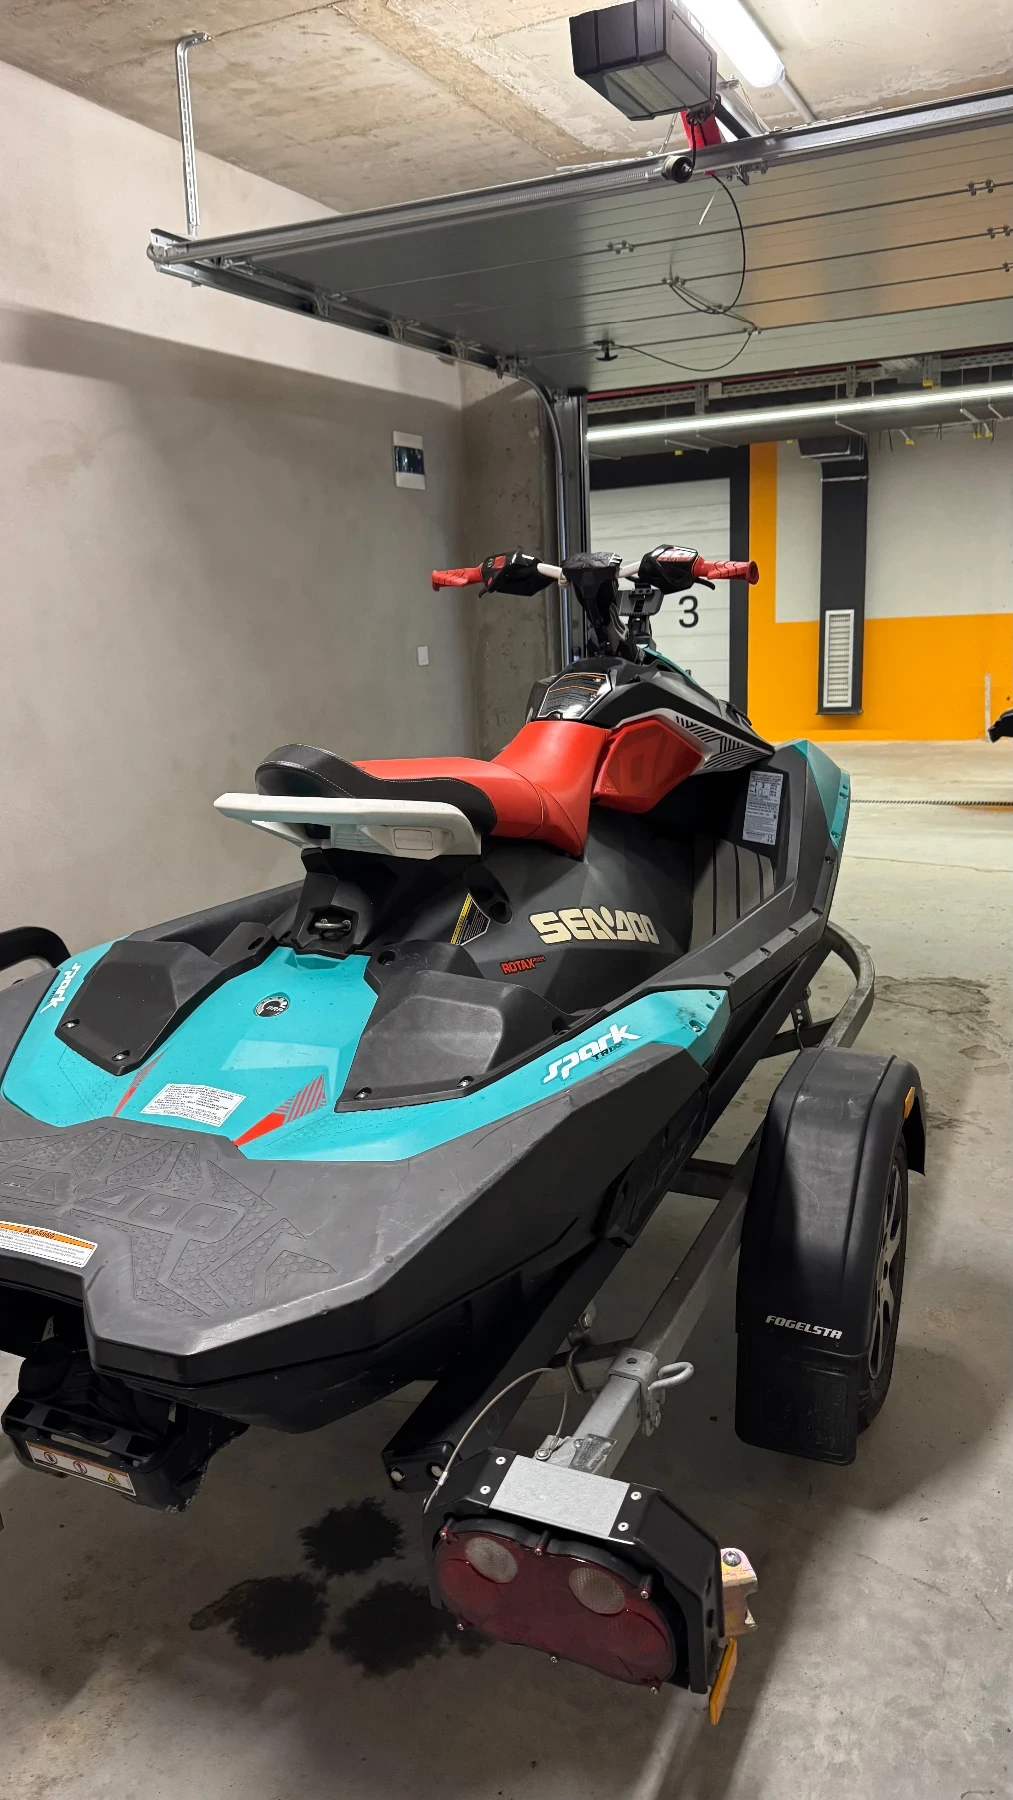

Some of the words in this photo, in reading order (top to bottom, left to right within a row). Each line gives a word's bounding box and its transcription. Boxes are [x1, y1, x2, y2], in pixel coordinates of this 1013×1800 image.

[678, 595, 699, 628] 3
[501, 958, 536, 975] ROTAX
[765, 1315, 843, 1340] FOGELSTA
